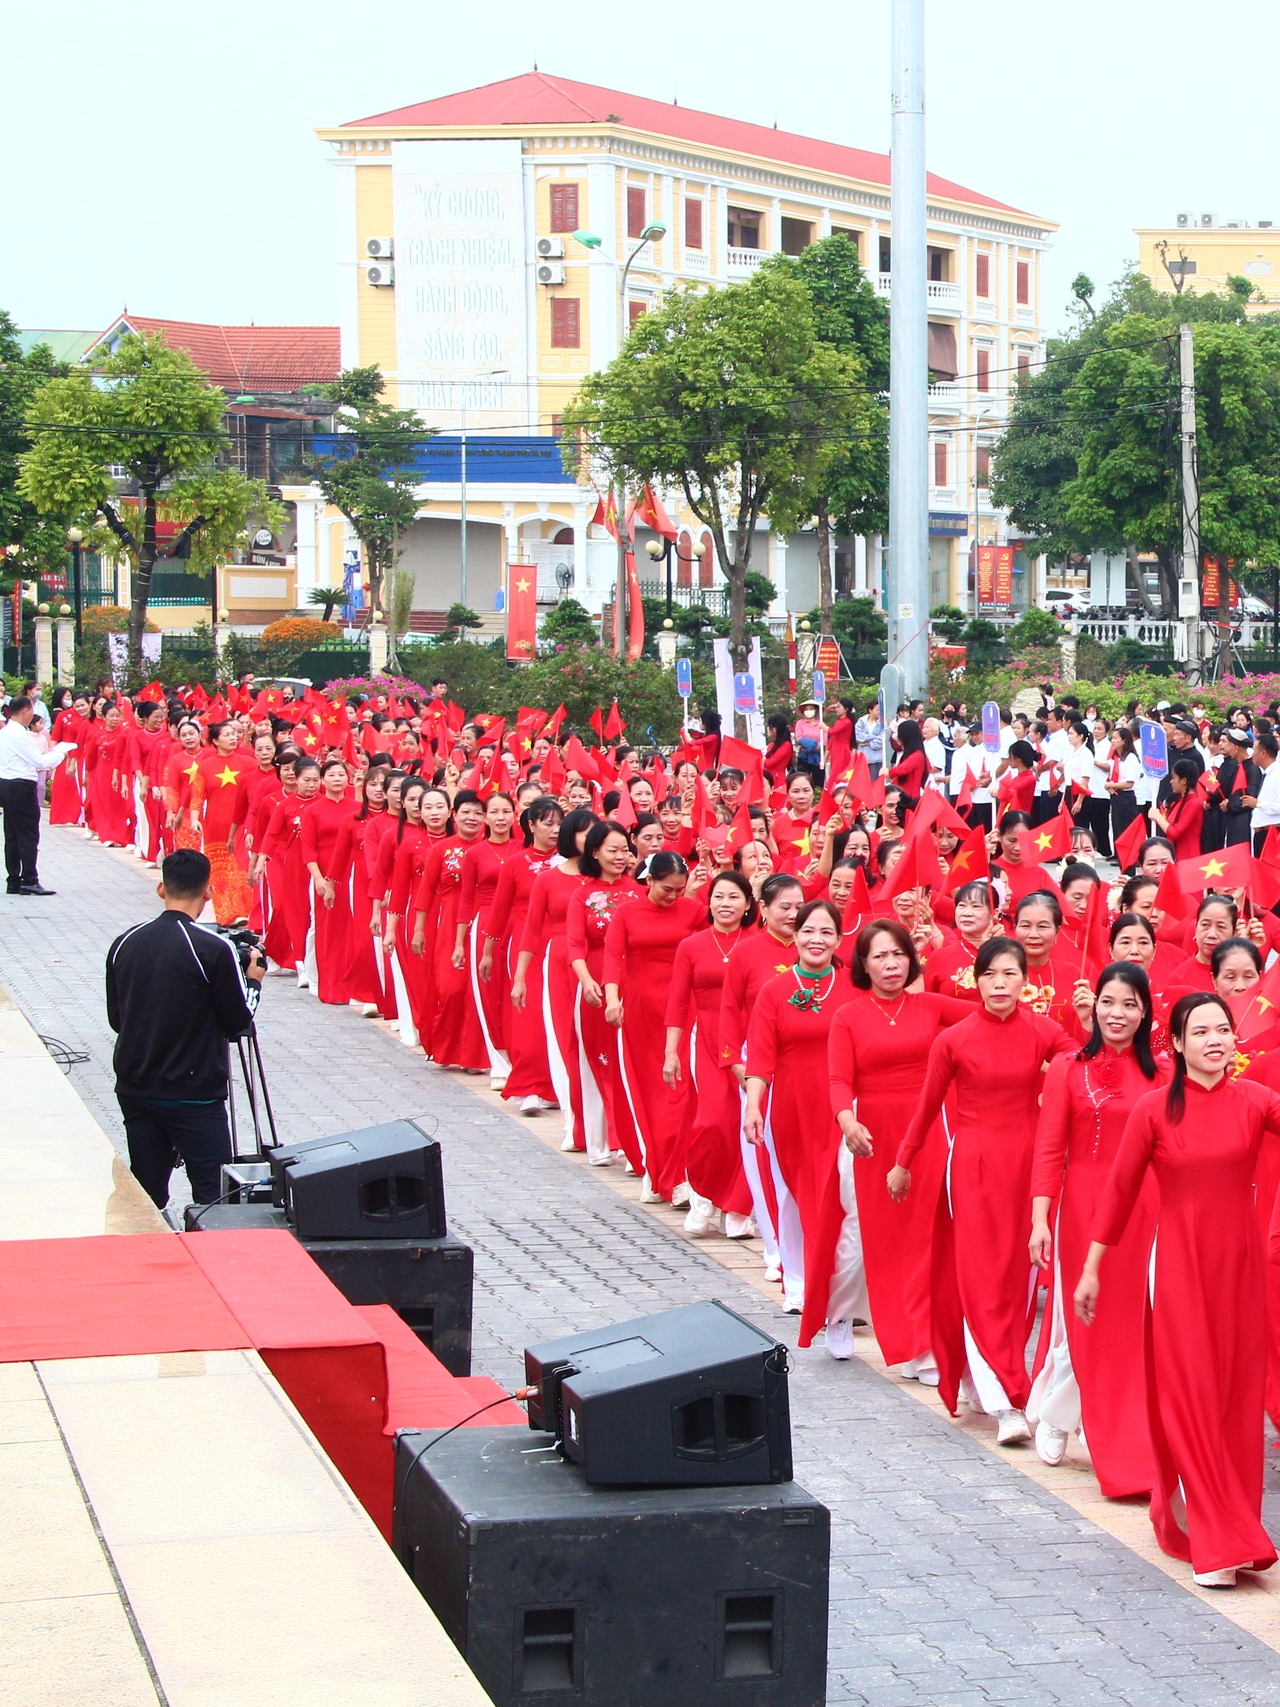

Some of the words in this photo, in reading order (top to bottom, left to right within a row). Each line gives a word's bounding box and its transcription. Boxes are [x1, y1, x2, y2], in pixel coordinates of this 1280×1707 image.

[406, 233, 455, 266] TRÁCH
[460, 233, 516, 271] NHIỆM,
[415, 280, 457, 313] HÀNH
[460, 280, 509, 318] ĐỘNG,
[424, 328, 465, 361] SÁNG
[470, 333, 503, 366] TẠO,
[252, 555, 266, 564] BÚN
